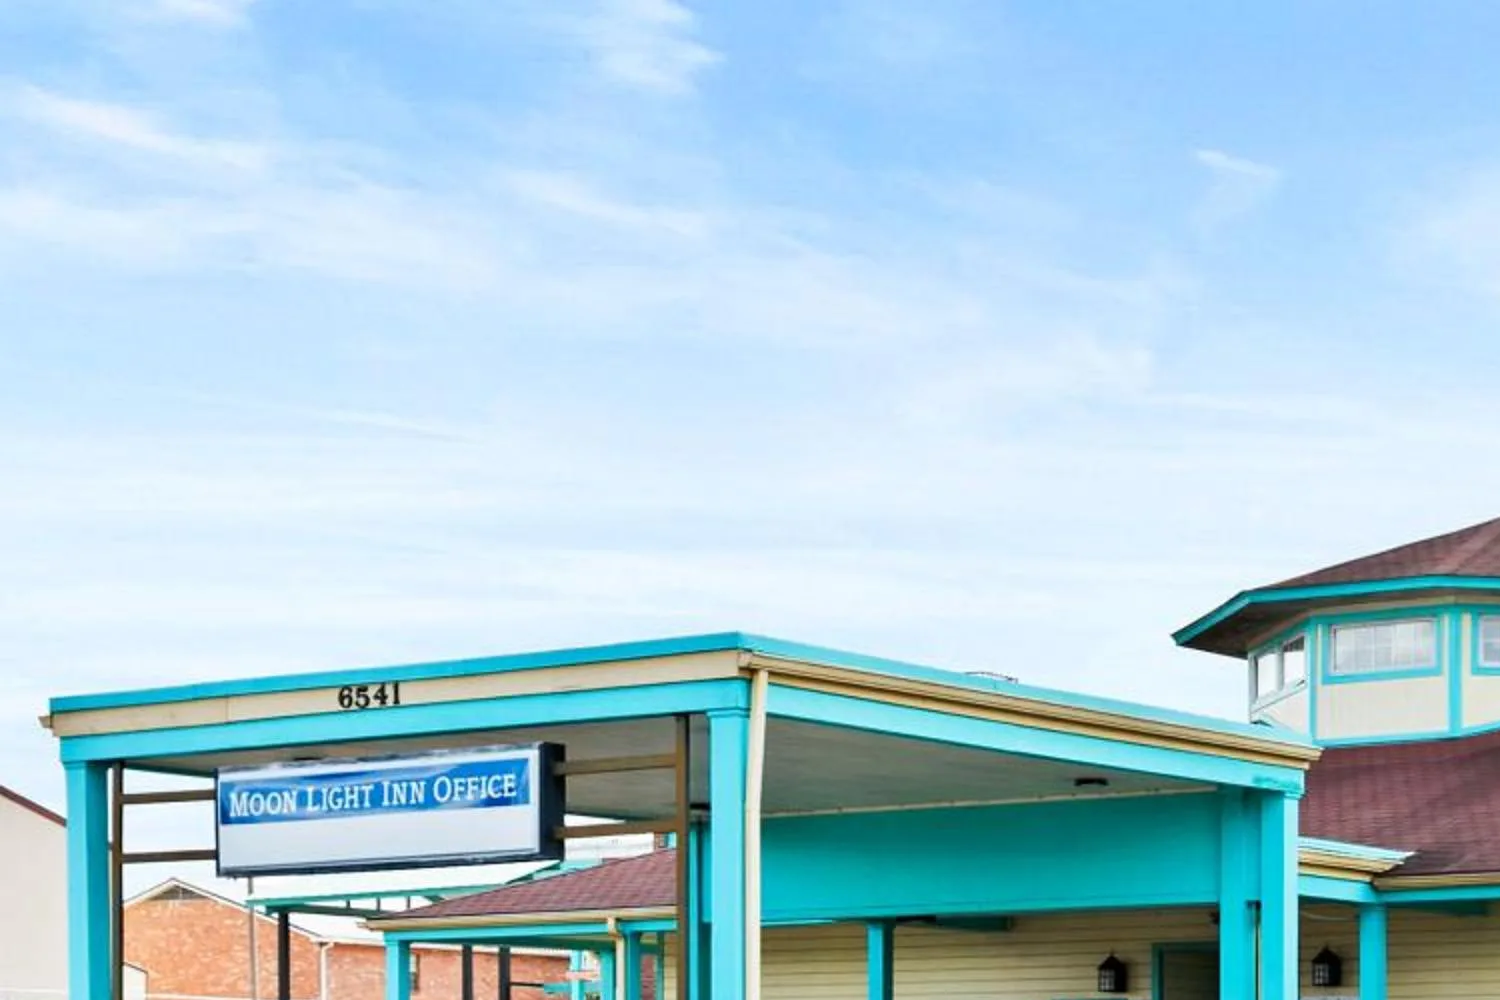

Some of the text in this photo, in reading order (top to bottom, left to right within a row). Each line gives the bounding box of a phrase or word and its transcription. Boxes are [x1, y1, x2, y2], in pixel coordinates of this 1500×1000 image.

[338, 680, 400, 708] 6541
[229, 773, 517, 817] MOON LIGHT INN OFFICE
